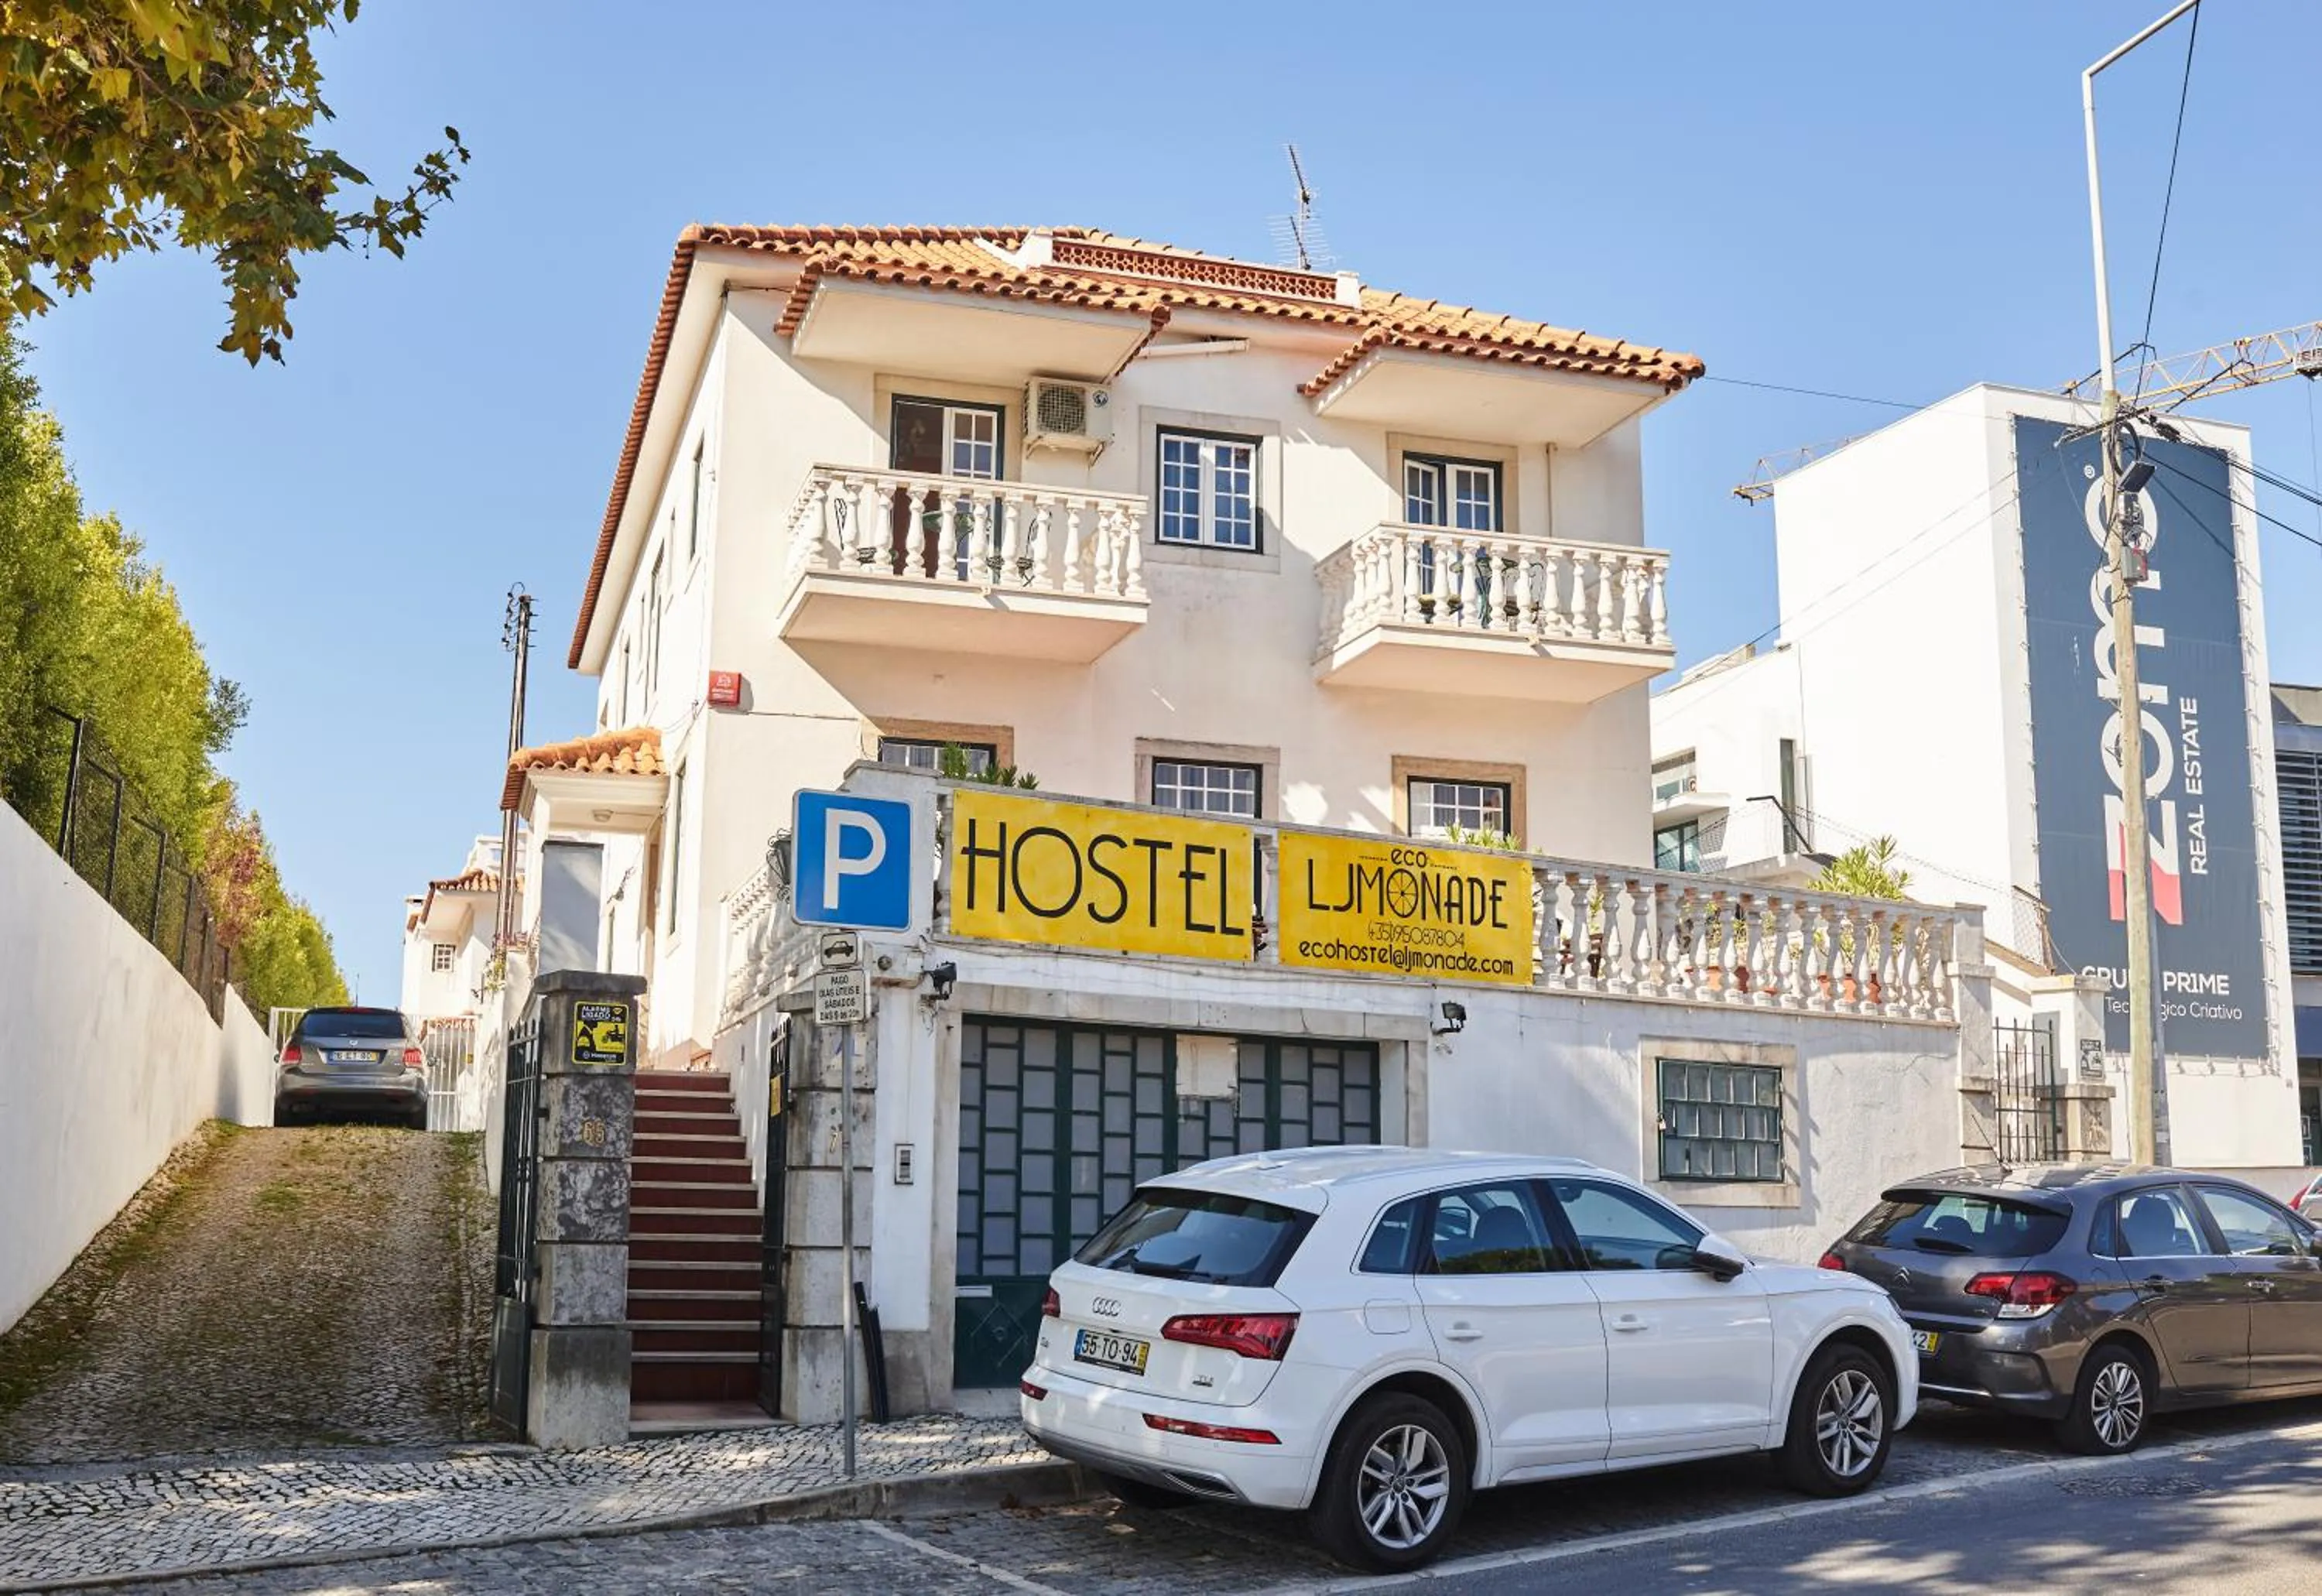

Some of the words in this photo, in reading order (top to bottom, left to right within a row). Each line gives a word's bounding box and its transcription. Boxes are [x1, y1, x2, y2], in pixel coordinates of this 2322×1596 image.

[2180, 697, 2204, 795] ESTATE
[823, 808, 886, 910] P
[961, 817, 1245, 937] HOSTEL
[1391, 848, 1428, 868] eco
[2188, 804, 2208, 875] REAL
[2190, 1002, 2242, 1020] Criativo
